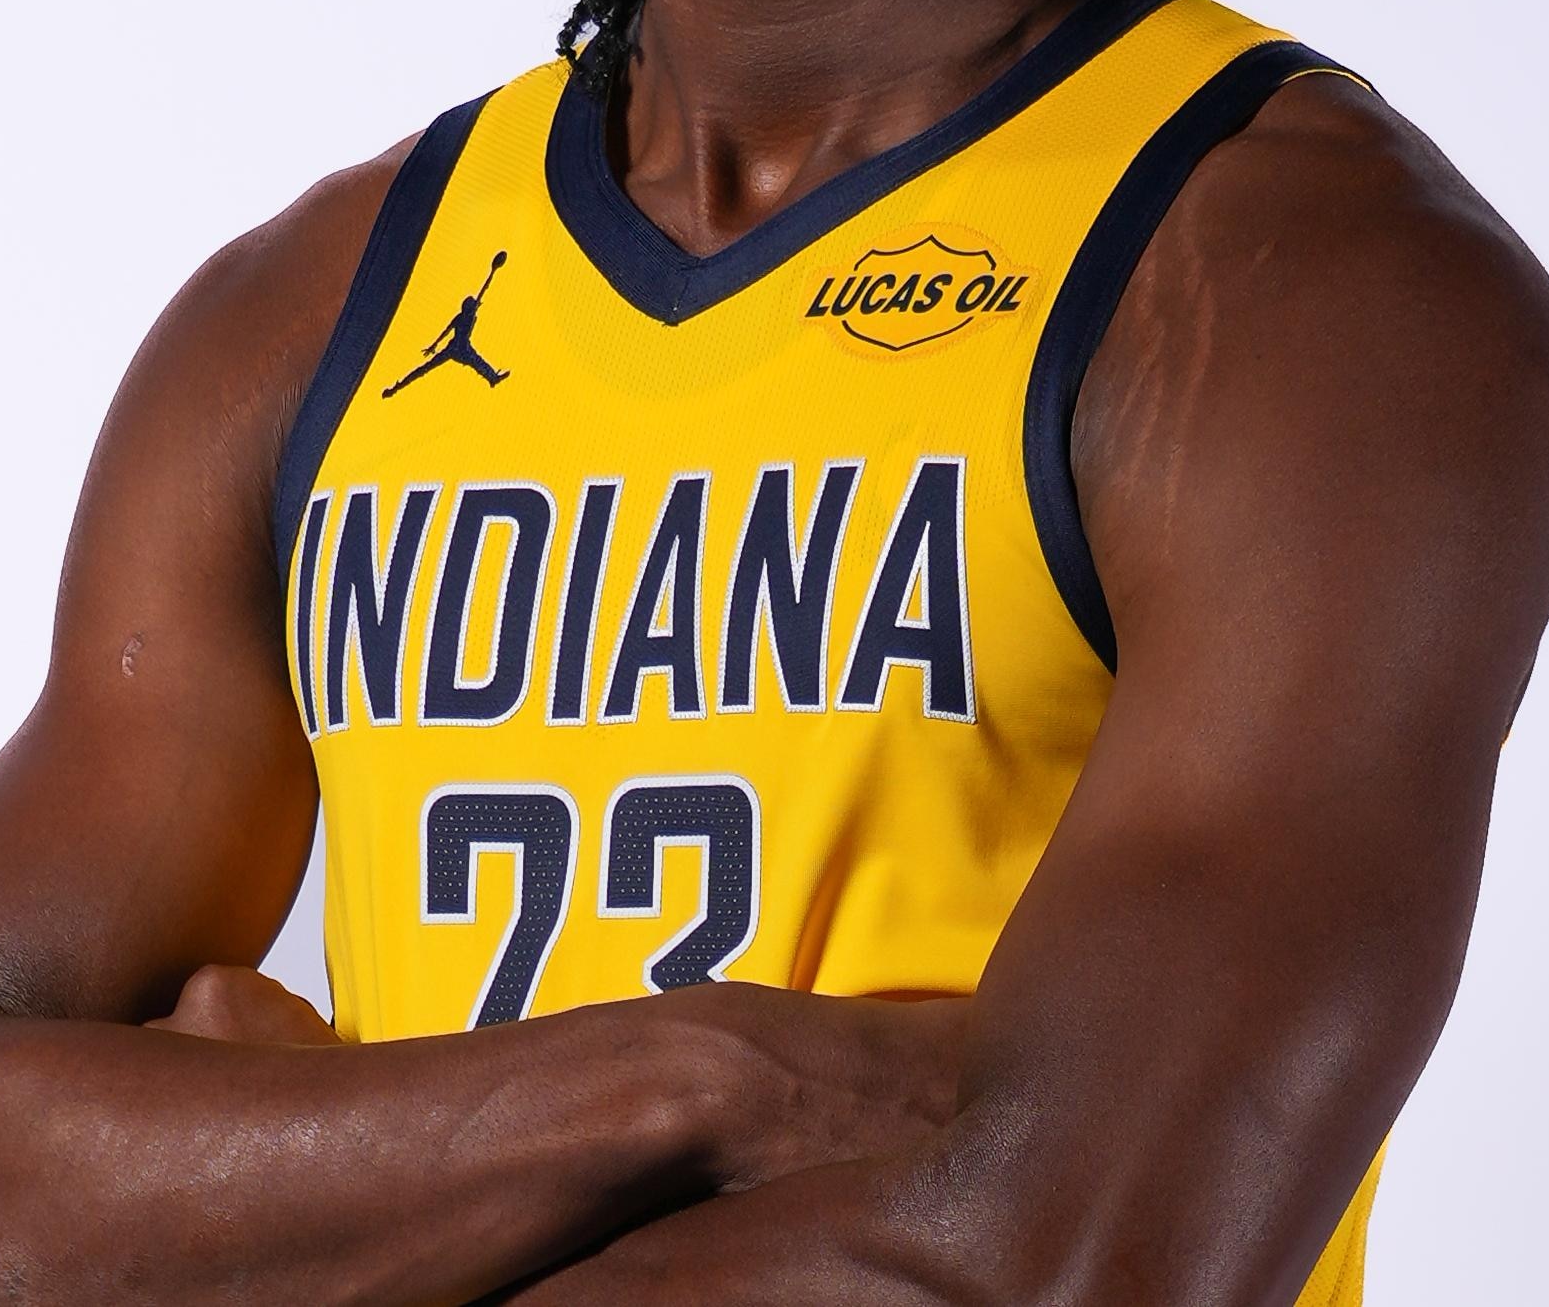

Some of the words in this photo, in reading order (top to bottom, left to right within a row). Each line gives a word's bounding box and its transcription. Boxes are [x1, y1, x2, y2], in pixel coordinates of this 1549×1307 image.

[805, 274, 953, 317] LUCAS
[955, 275, 1029, 313] OIL
[286, 454, 978, 741] INDIANA
